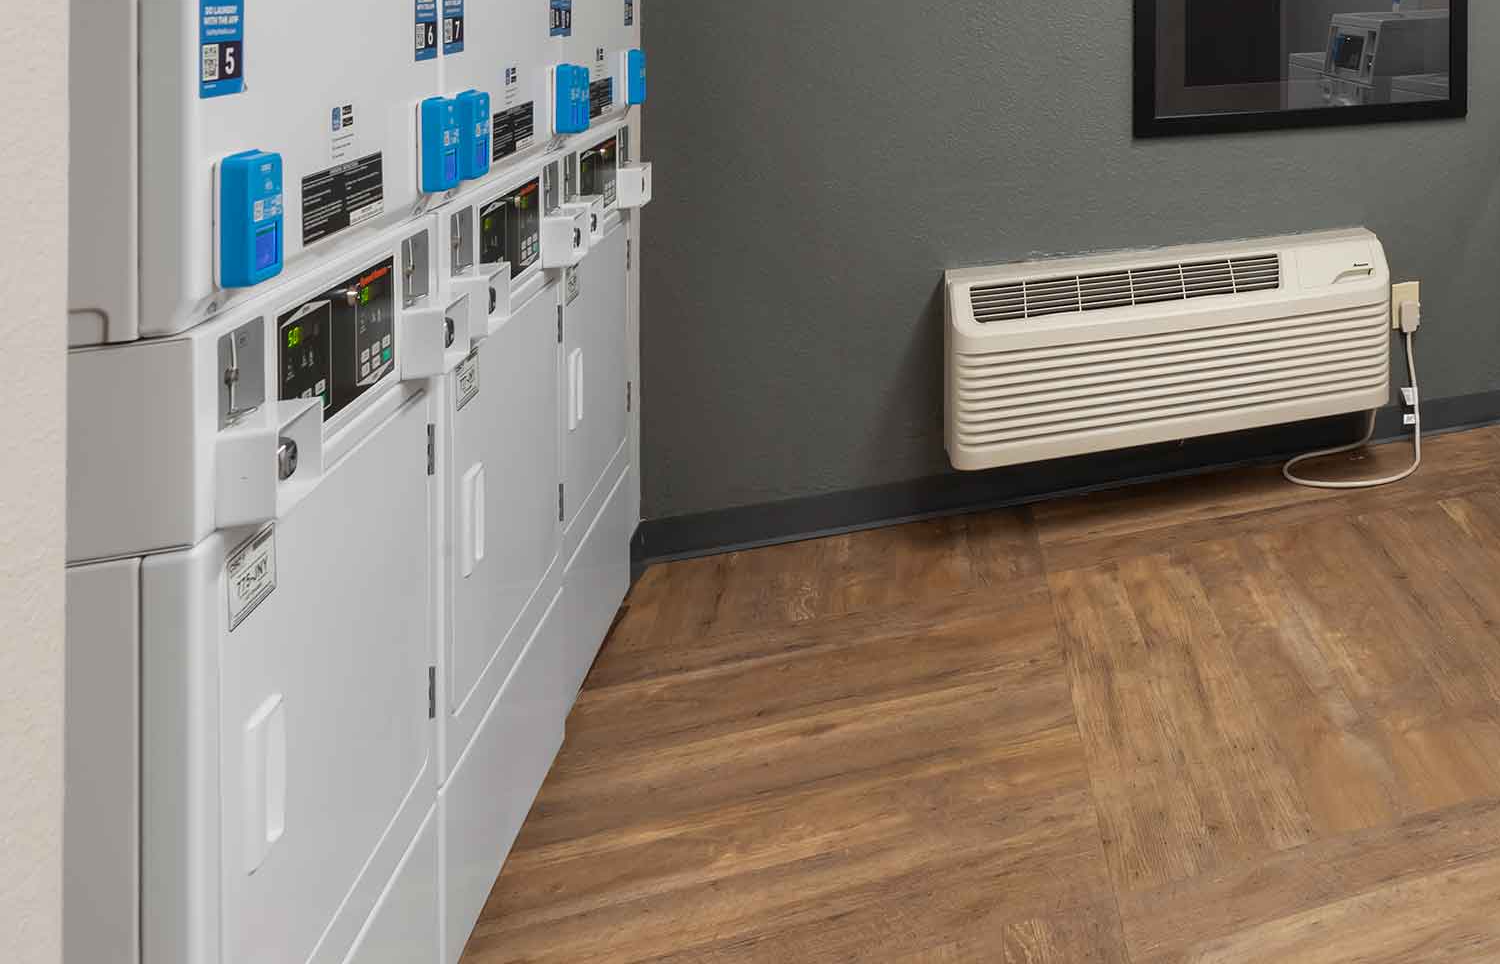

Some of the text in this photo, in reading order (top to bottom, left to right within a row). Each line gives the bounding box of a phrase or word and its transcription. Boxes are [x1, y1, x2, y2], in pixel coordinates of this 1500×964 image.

[427, 25, 434, 45] 6
[455, 20, 461, 40] 7
[224, 47, 235, 75] 5
